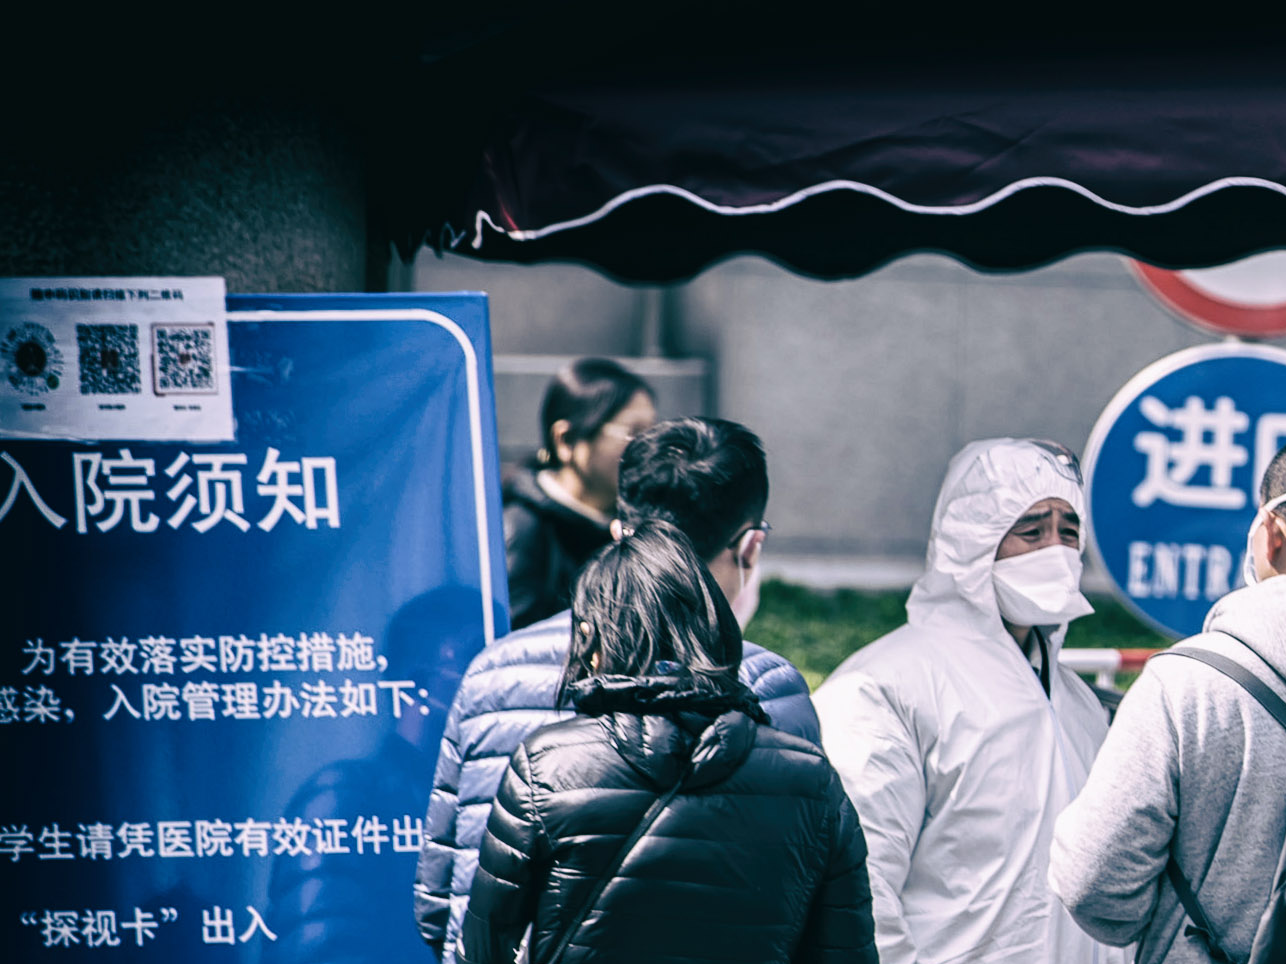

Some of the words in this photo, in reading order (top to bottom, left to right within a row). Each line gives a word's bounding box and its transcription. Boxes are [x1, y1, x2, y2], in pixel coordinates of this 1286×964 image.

[0, 447, 342, 534] 入院须知
[1128, 541, 1243, 600] ENTR
[21, 632, 389, 675] 为有效落实防控措施，
[0, 814, 424, 862] 学生请凭医院有效证件出
[20, 906, 278, 947] “探视卡”出入
